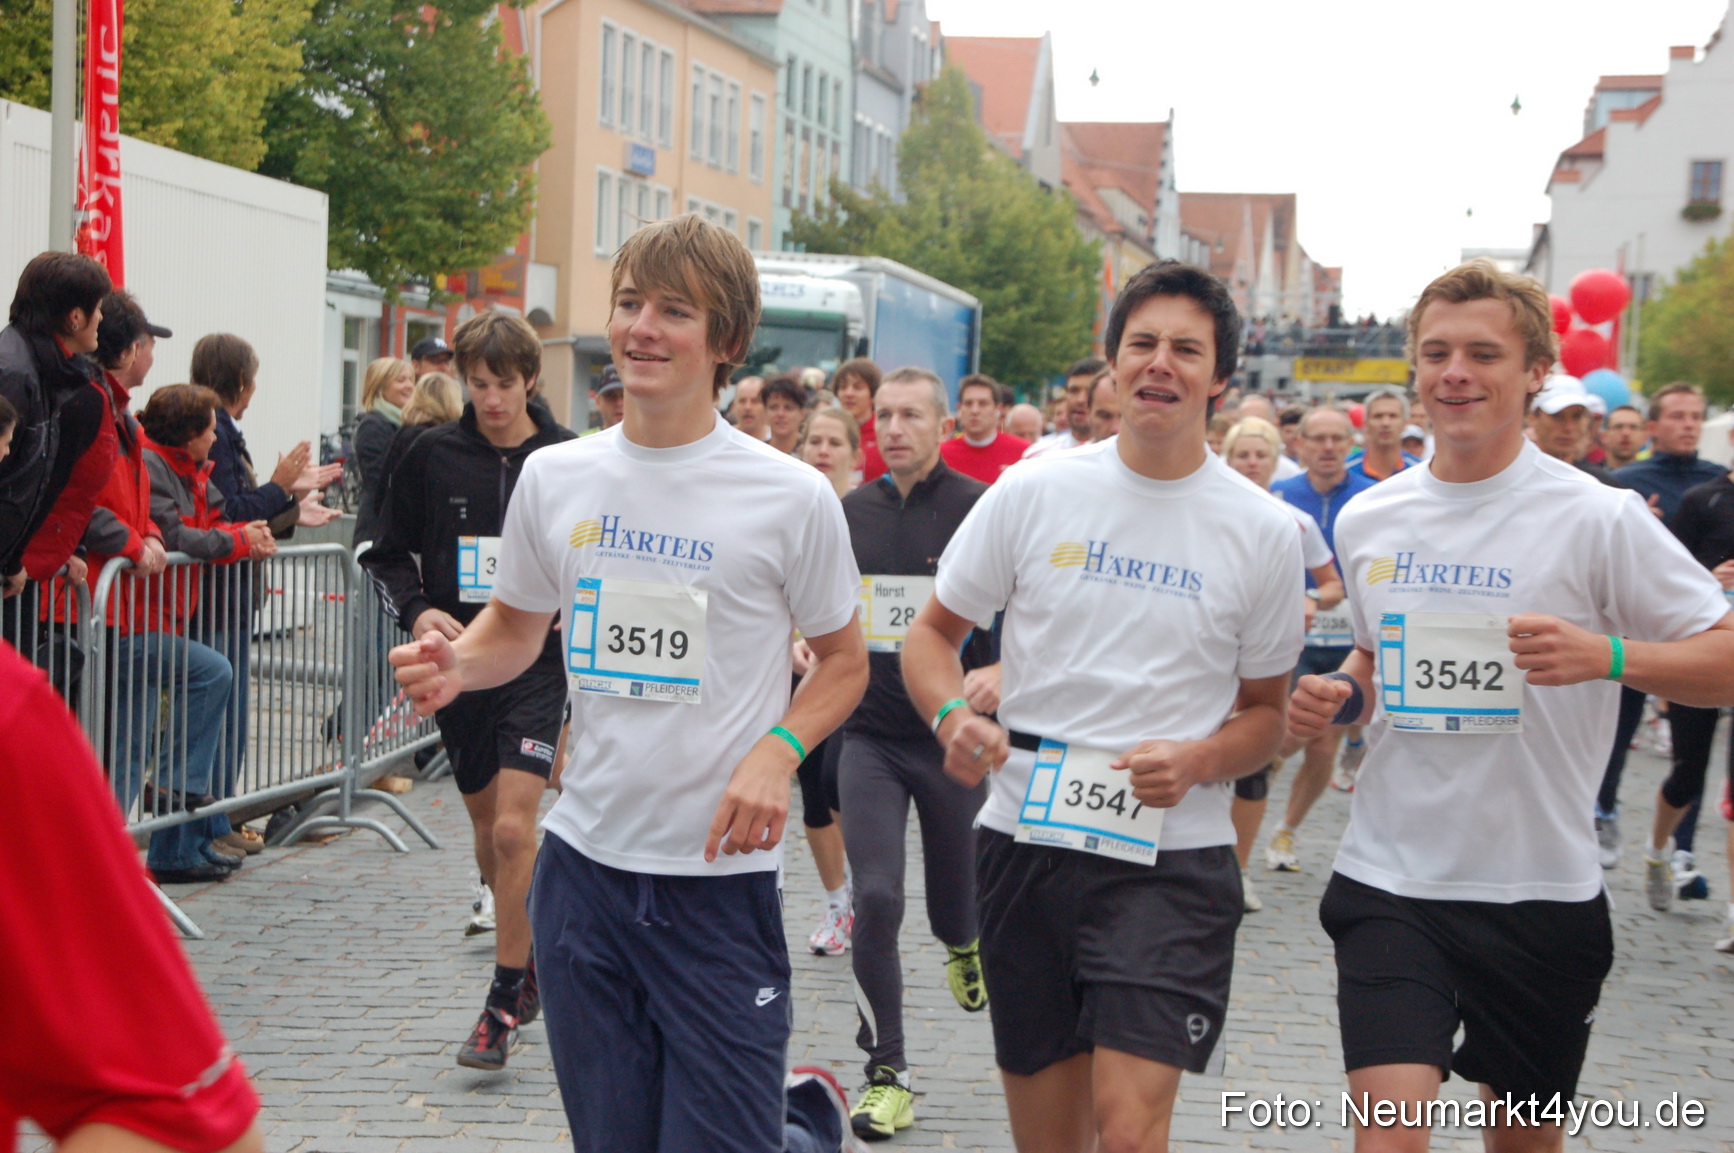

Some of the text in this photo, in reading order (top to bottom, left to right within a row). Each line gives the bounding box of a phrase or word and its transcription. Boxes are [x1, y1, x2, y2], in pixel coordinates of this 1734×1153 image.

[597, 515, 715, 563] HÄRTEIS
[635, 555, 657, 563] WEINE
[662, 559, 711, 571] ZELTVERLEIH
[1082, 540, 1203, 592] HÄRTEIS
[1391, 552, 1512, 589] HÄRTEIS
[875, 583, 905, 597] Horst
[607, 624, 689, 660] 3519
[645, 682, 699, 697] PFLEIDERER
[1415, 659, 1504, 691] 3542
[1100, 837, 1154, 858] PFLEIDERER
